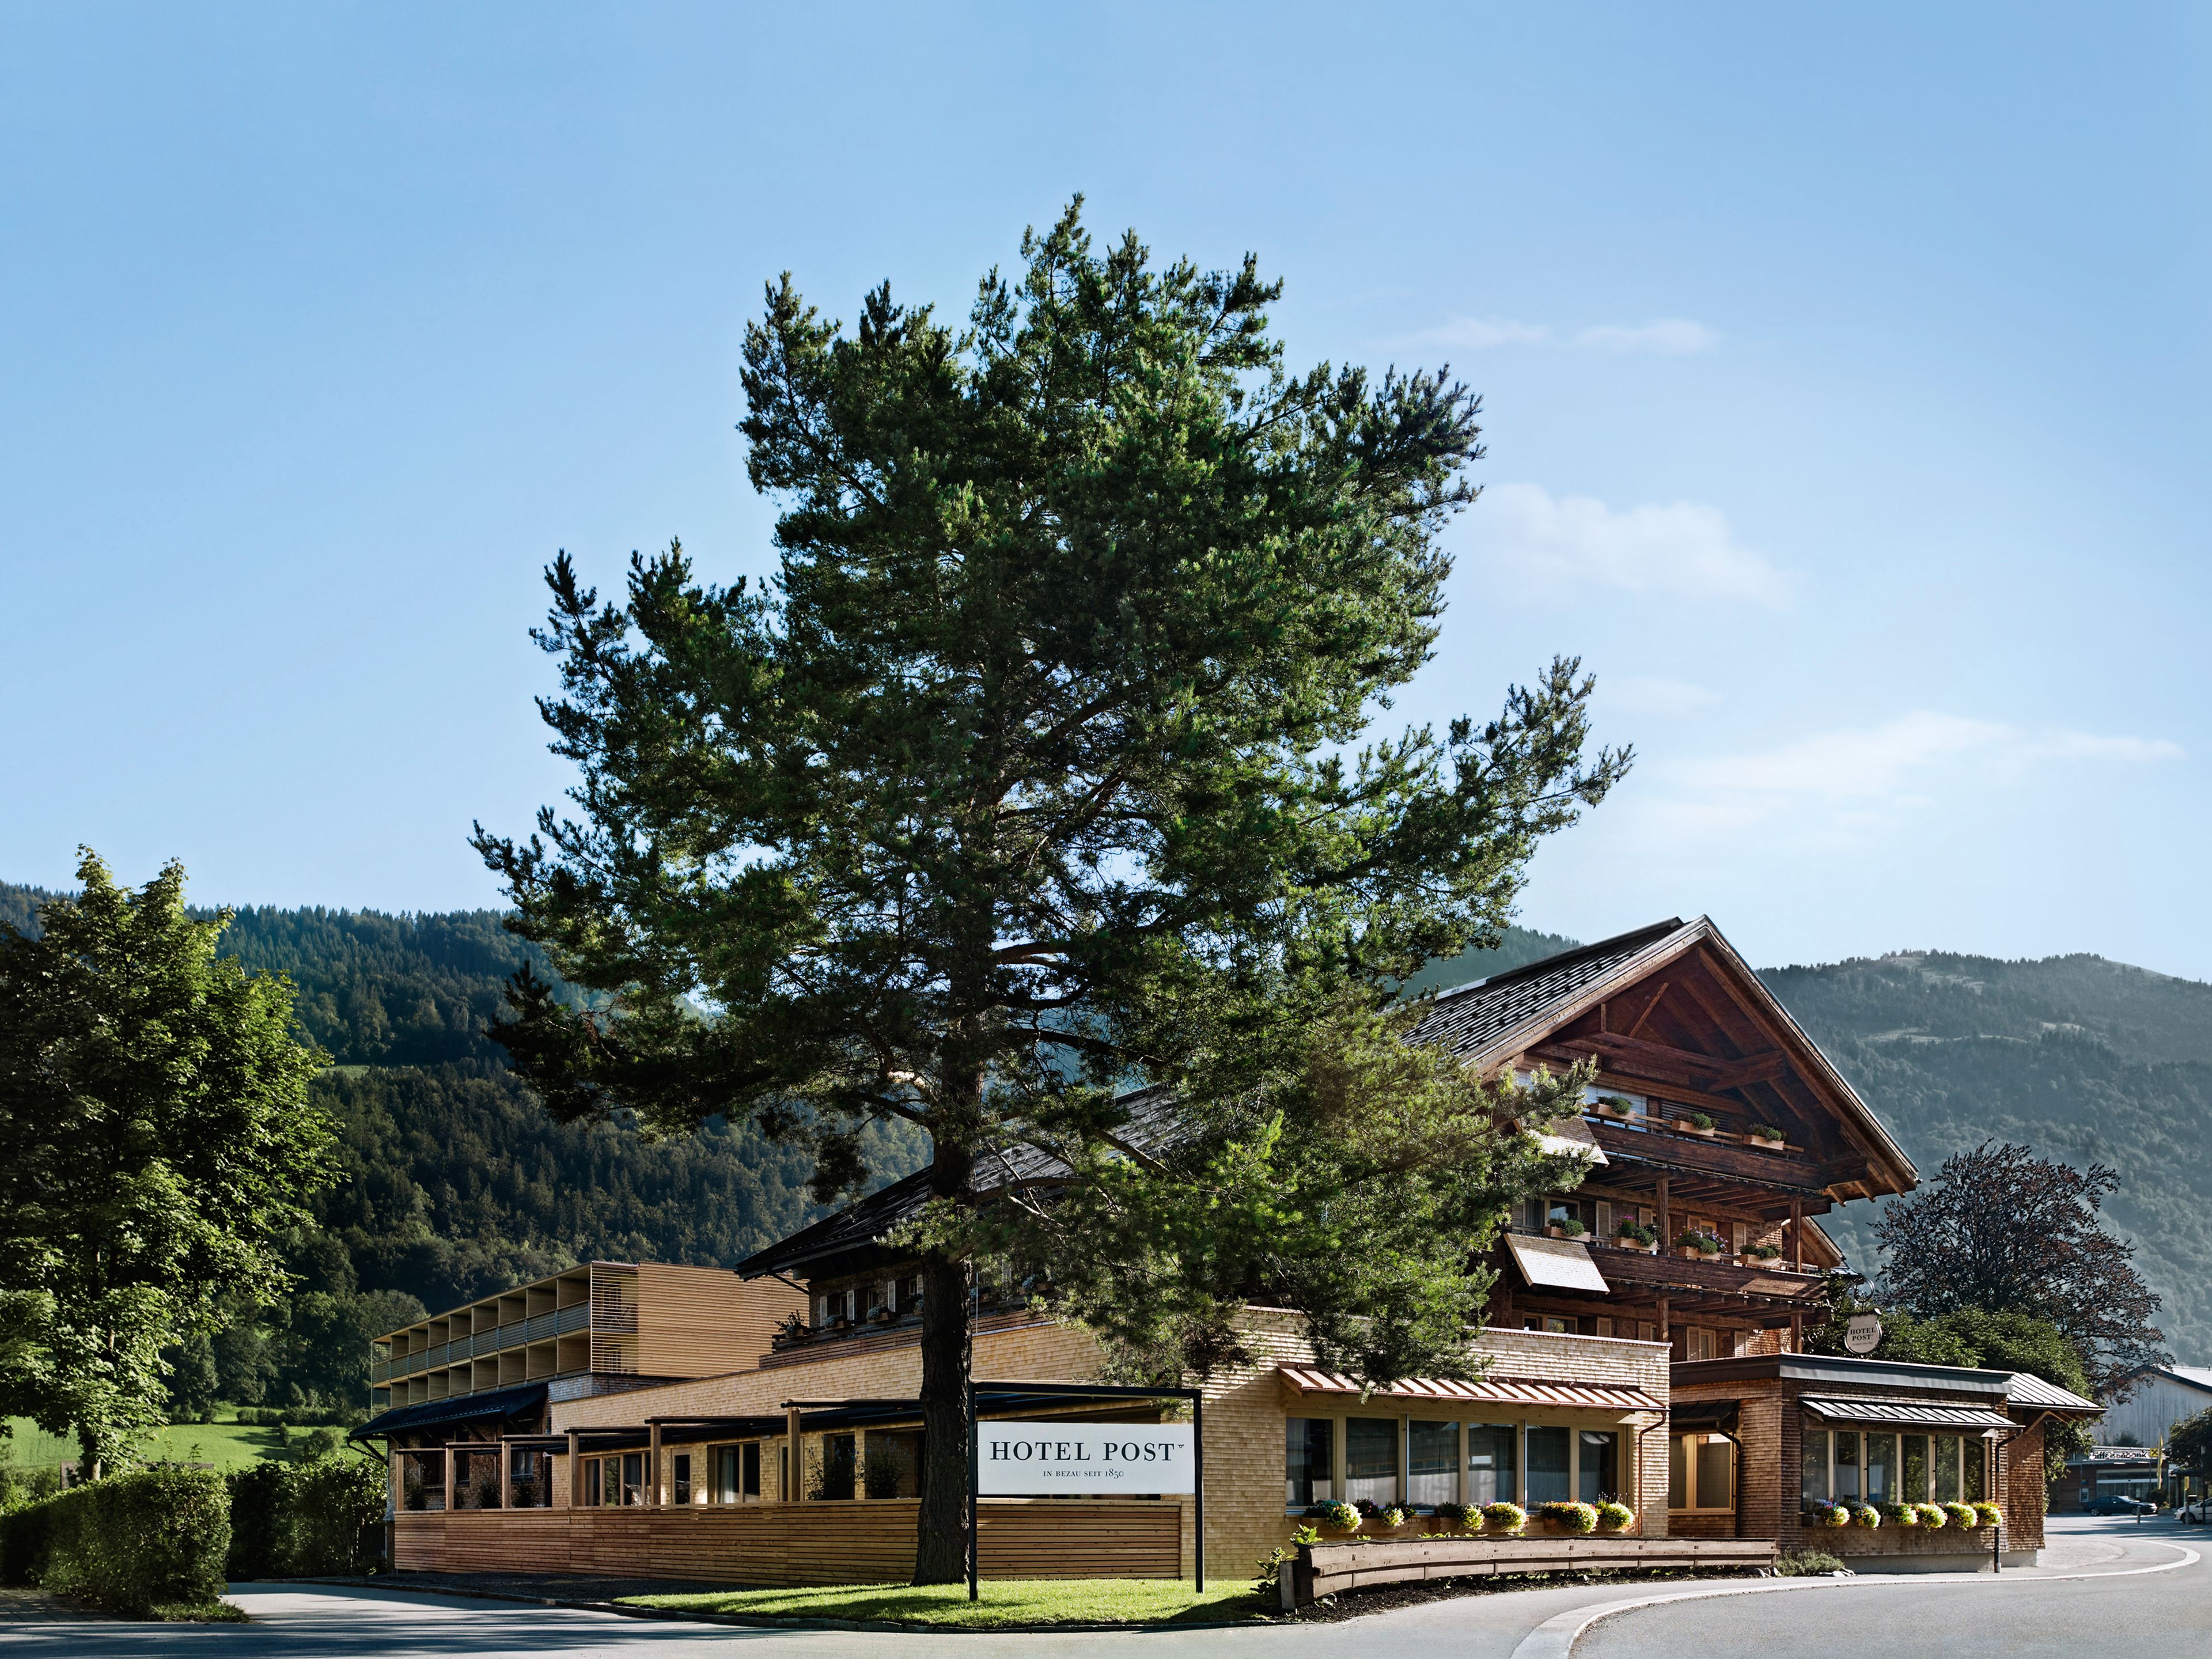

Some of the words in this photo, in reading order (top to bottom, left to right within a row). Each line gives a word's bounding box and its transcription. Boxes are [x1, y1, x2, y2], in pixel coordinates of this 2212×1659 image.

[990, 1441, 1090, 1461] HOTEL
[1103, 1442, 1174, 1461] POST
[1105, 1468, 1124, 1479] 1850
